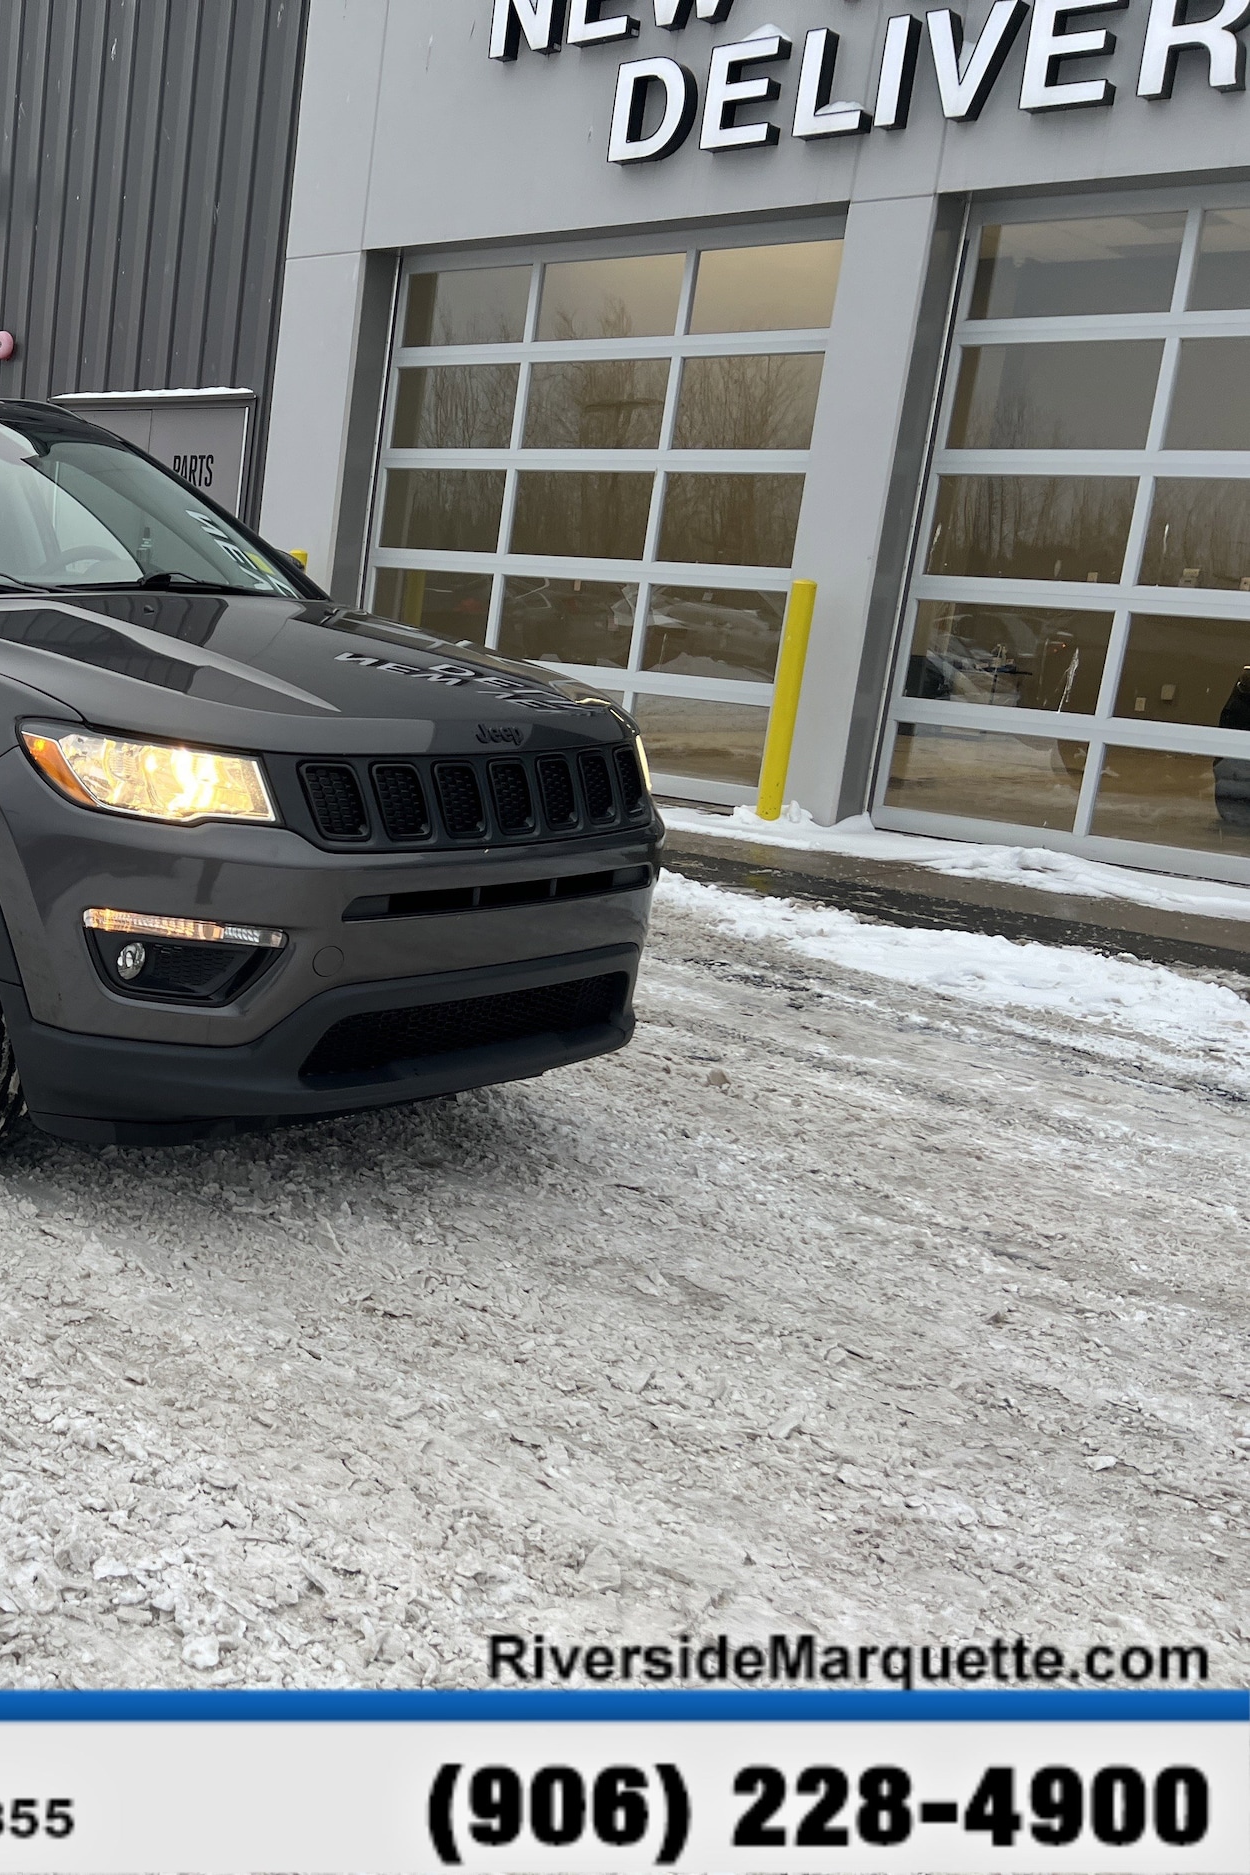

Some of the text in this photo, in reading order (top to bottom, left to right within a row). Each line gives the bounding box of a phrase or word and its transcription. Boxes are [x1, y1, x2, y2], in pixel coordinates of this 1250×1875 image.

[607, 0, 1249, 165] DELIVER
[173, 454, 214, 487] PARTS
[475, 723, 524, 746] Jeep
